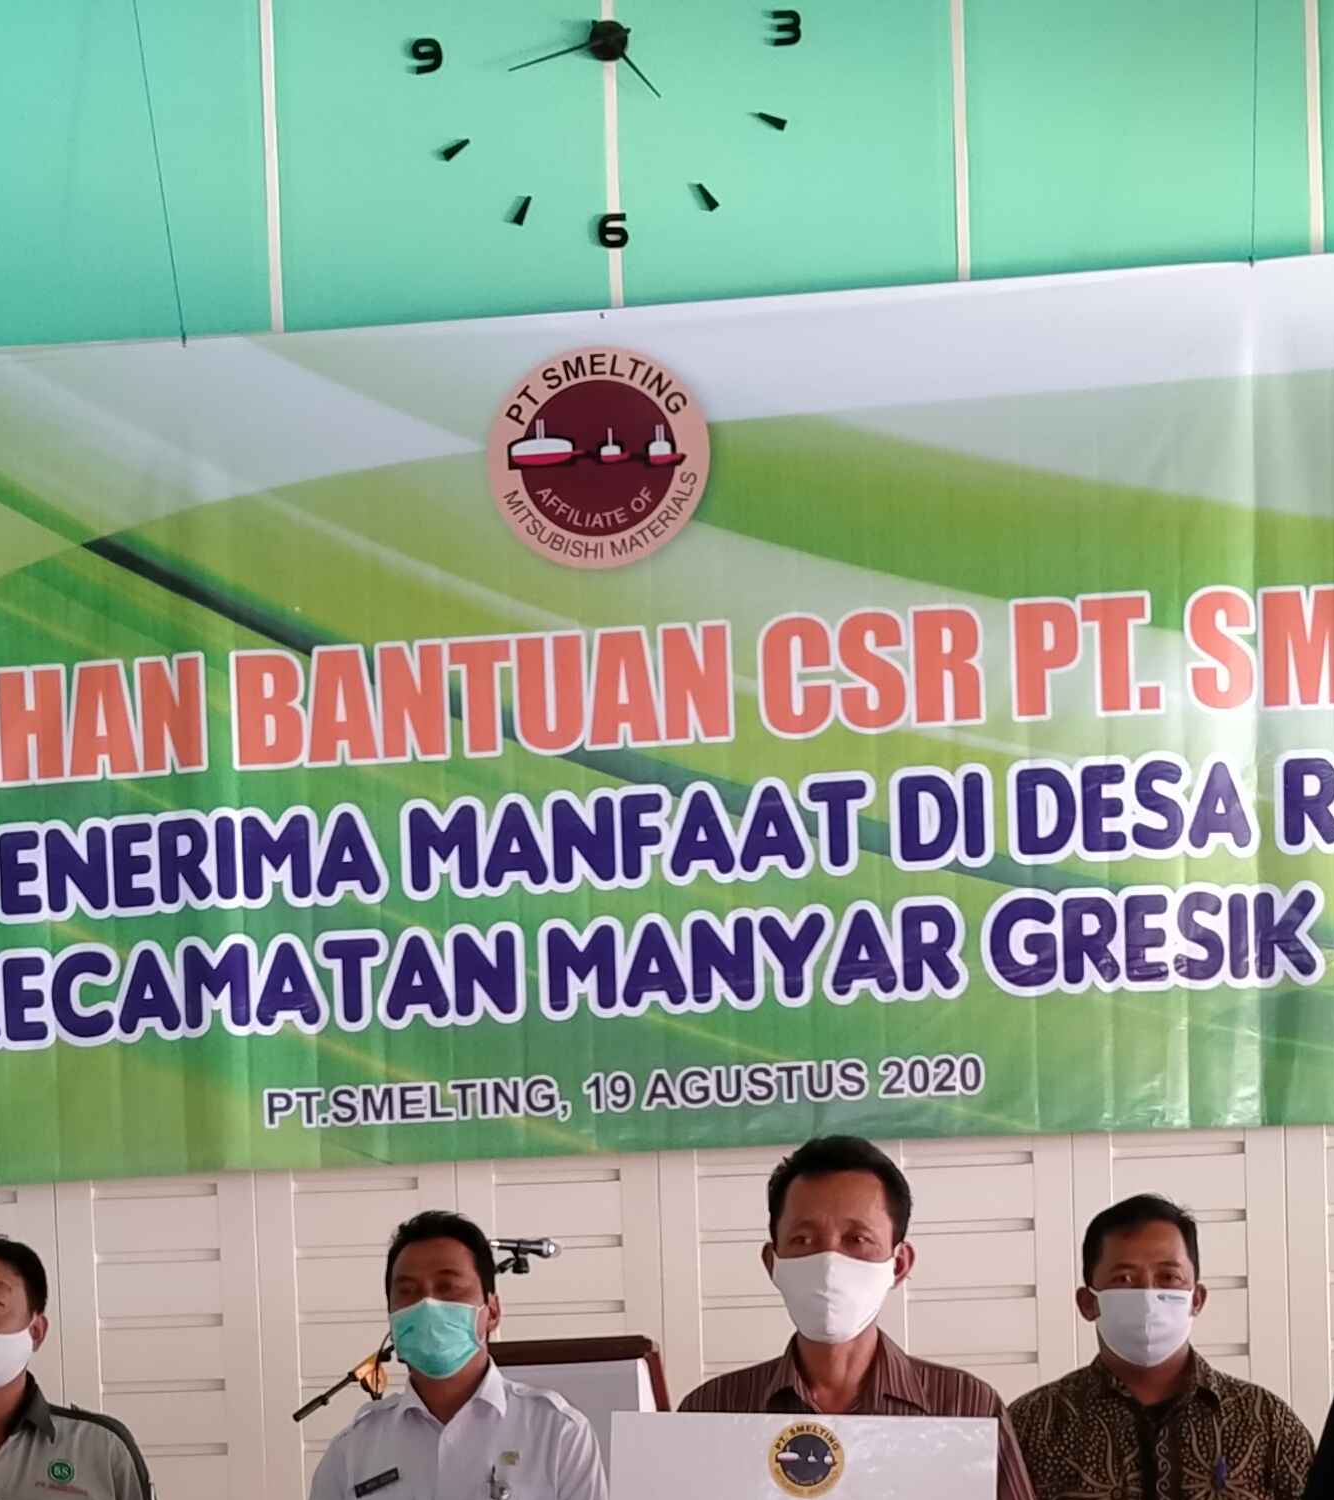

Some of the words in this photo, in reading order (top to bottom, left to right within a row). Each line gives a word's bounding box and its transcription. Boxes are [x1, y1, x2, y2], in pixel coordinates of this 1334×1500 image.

[411, 38, 443, 74] 9
[773, 10, 801, 46] 3
[597, 213, 628, 248] 6
[505, 385, 539, 425] PT
[542, 354, 687, 415] SMELTING
[503, 490, 604, 559] MITSUBISHI
[610, 471, 698, 557] MATERIALS
[536, 488, 628, 528] AFFILIATE
[630, 486, 653, 512] OF
[234, 622, 731, 770] BANTUAN
[761, 607, 981, 738] CSR
[1013, 594, 1162, 717] PT.
[408, 781, 863, 890] MANFAAT
[900, 763, 986, 865] DI
[1017, 760, 1252, 855] DESA
[550, 901, 958, 1016] MANYAR
[989, 887, 1318, 988] GRESIK
[268, 1080, 569, 1126] PT.SMELTING,
[590, 1076, 632, 1111] 19
[645, 1062, 865, 1108] AGUSTUS
[882, 1058, 981, 1095] 2020
